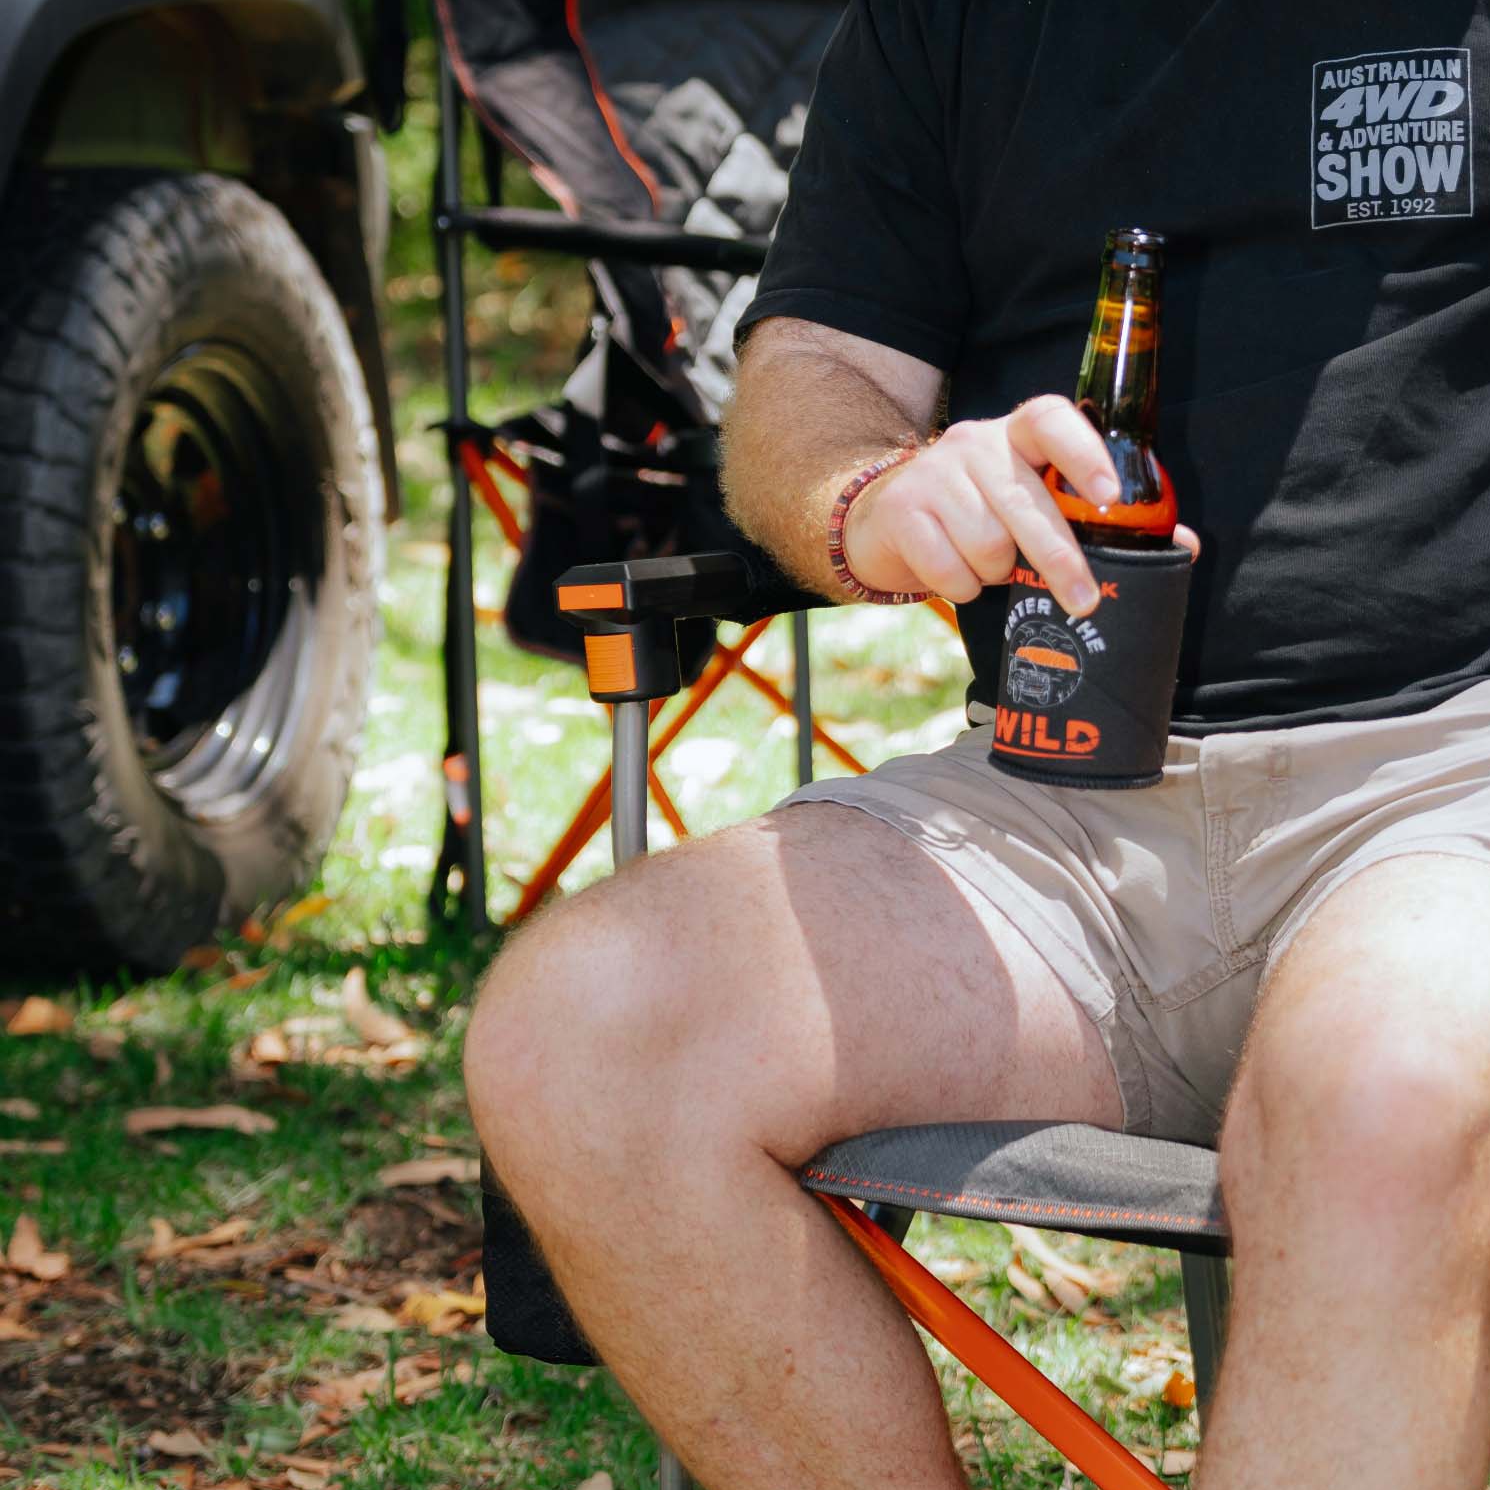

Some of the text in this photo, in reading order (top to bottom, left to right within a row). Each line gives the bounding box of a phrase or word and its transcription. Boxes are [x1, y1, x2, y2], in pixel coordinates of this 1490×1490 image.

[1320, 58, 1461, 90] AUSTRALIAN
[1320, 80, 1465, 128] 4WD
[1317, 120, 1465, 151] & ADVENTURE
[1316, 145, 1464, 201] SHOW
[1347, 197, 1436, 219] EST. 1992
[995, 704, 1100, 753] WILD
